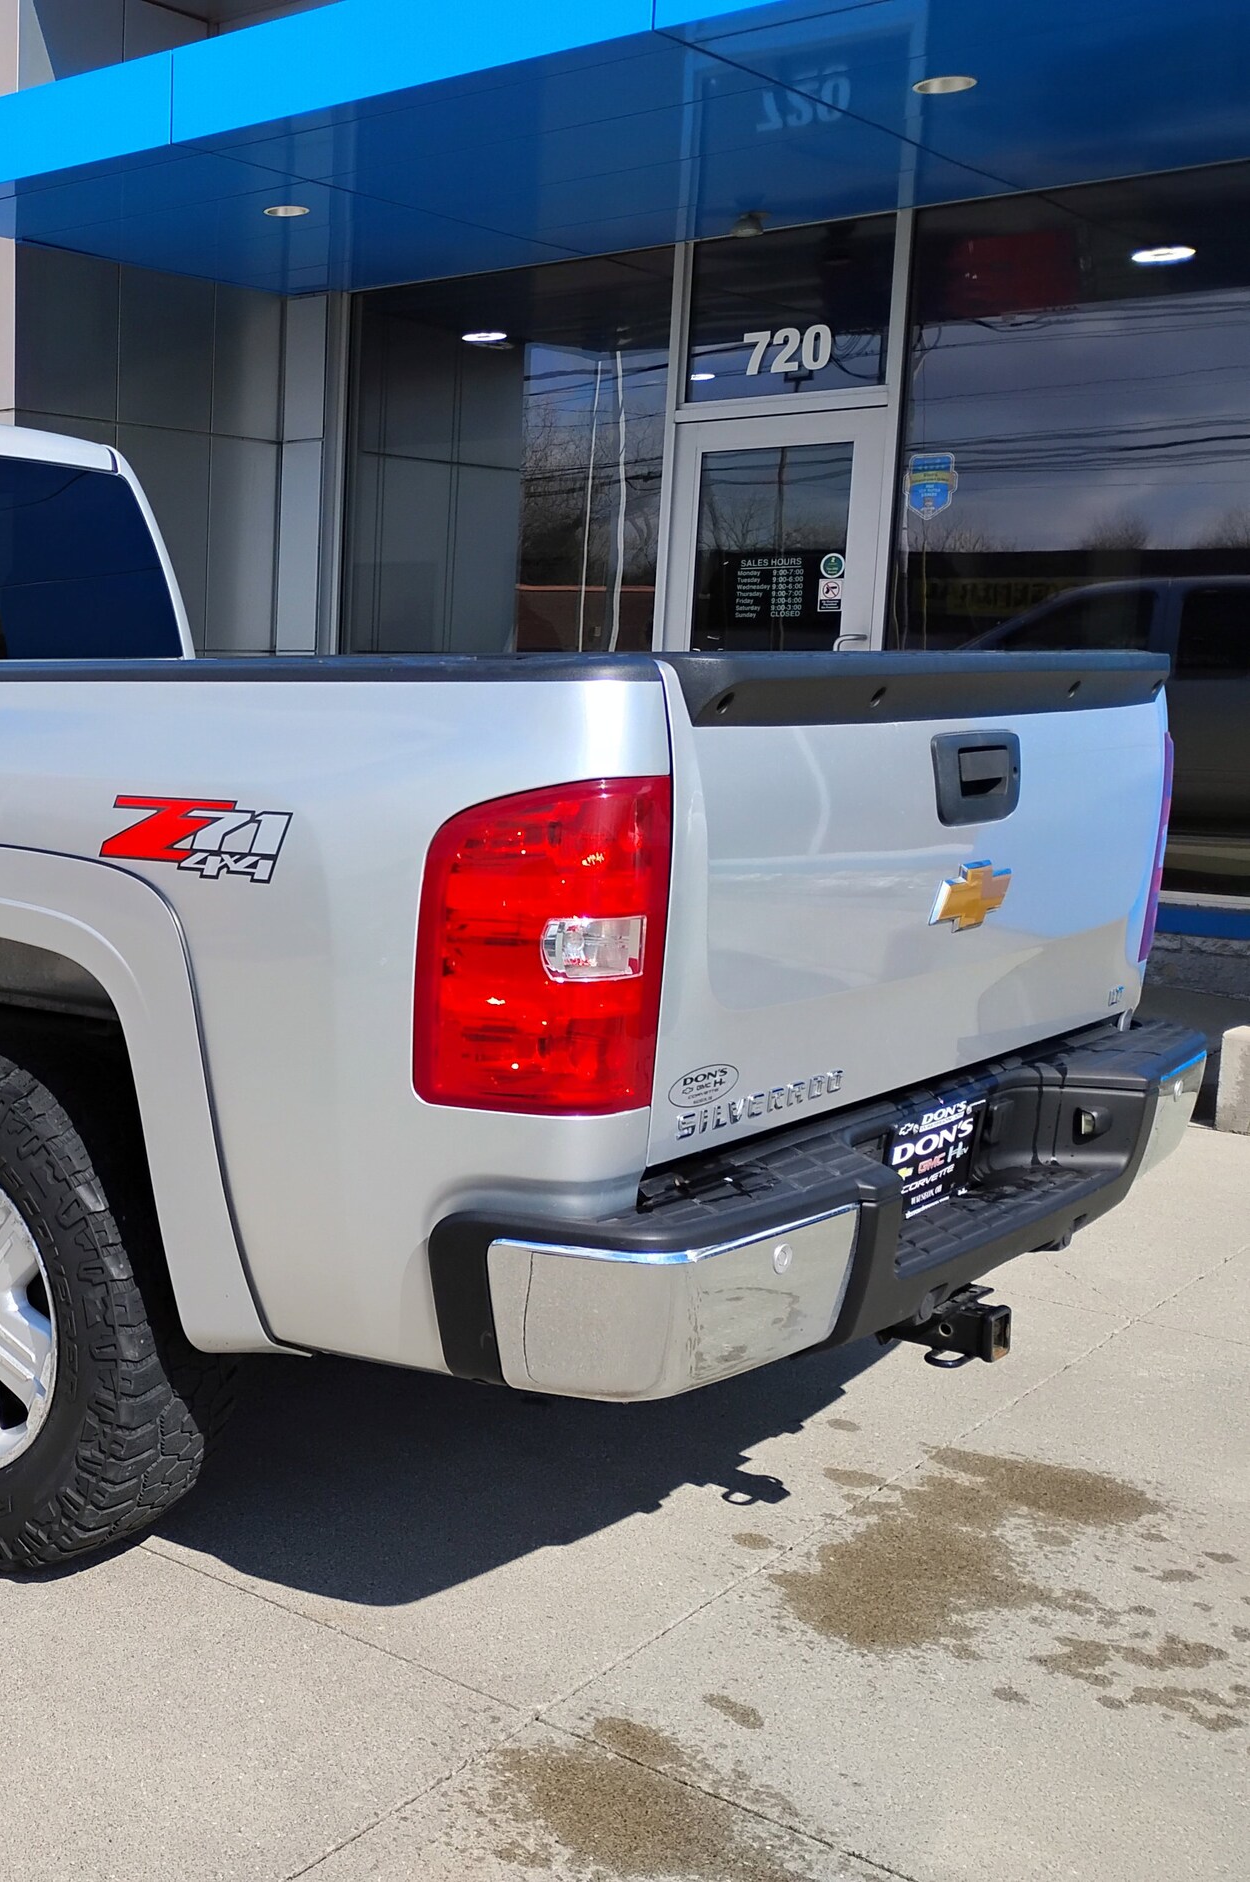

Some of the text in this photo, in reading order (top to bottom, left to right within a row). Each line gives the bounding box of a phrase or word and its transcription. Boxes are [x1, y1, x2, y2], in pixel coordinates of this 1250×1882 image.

[743, 324, 832, 376] 720
[740, 558, 802, 567] SALES HOURS
[99, 794, 293, 858] Z71
[682, 1068, 728, 1086] DON'S
[676, 1069, 843, 1141] SILVERADO
[921, 1100, 967, 1126] DON'S
[892, 1117, 974, 1166] DON'S
[900, 1163, 955, 1195] CORVETTE
[918, 1152, 946, 1175] GMC
